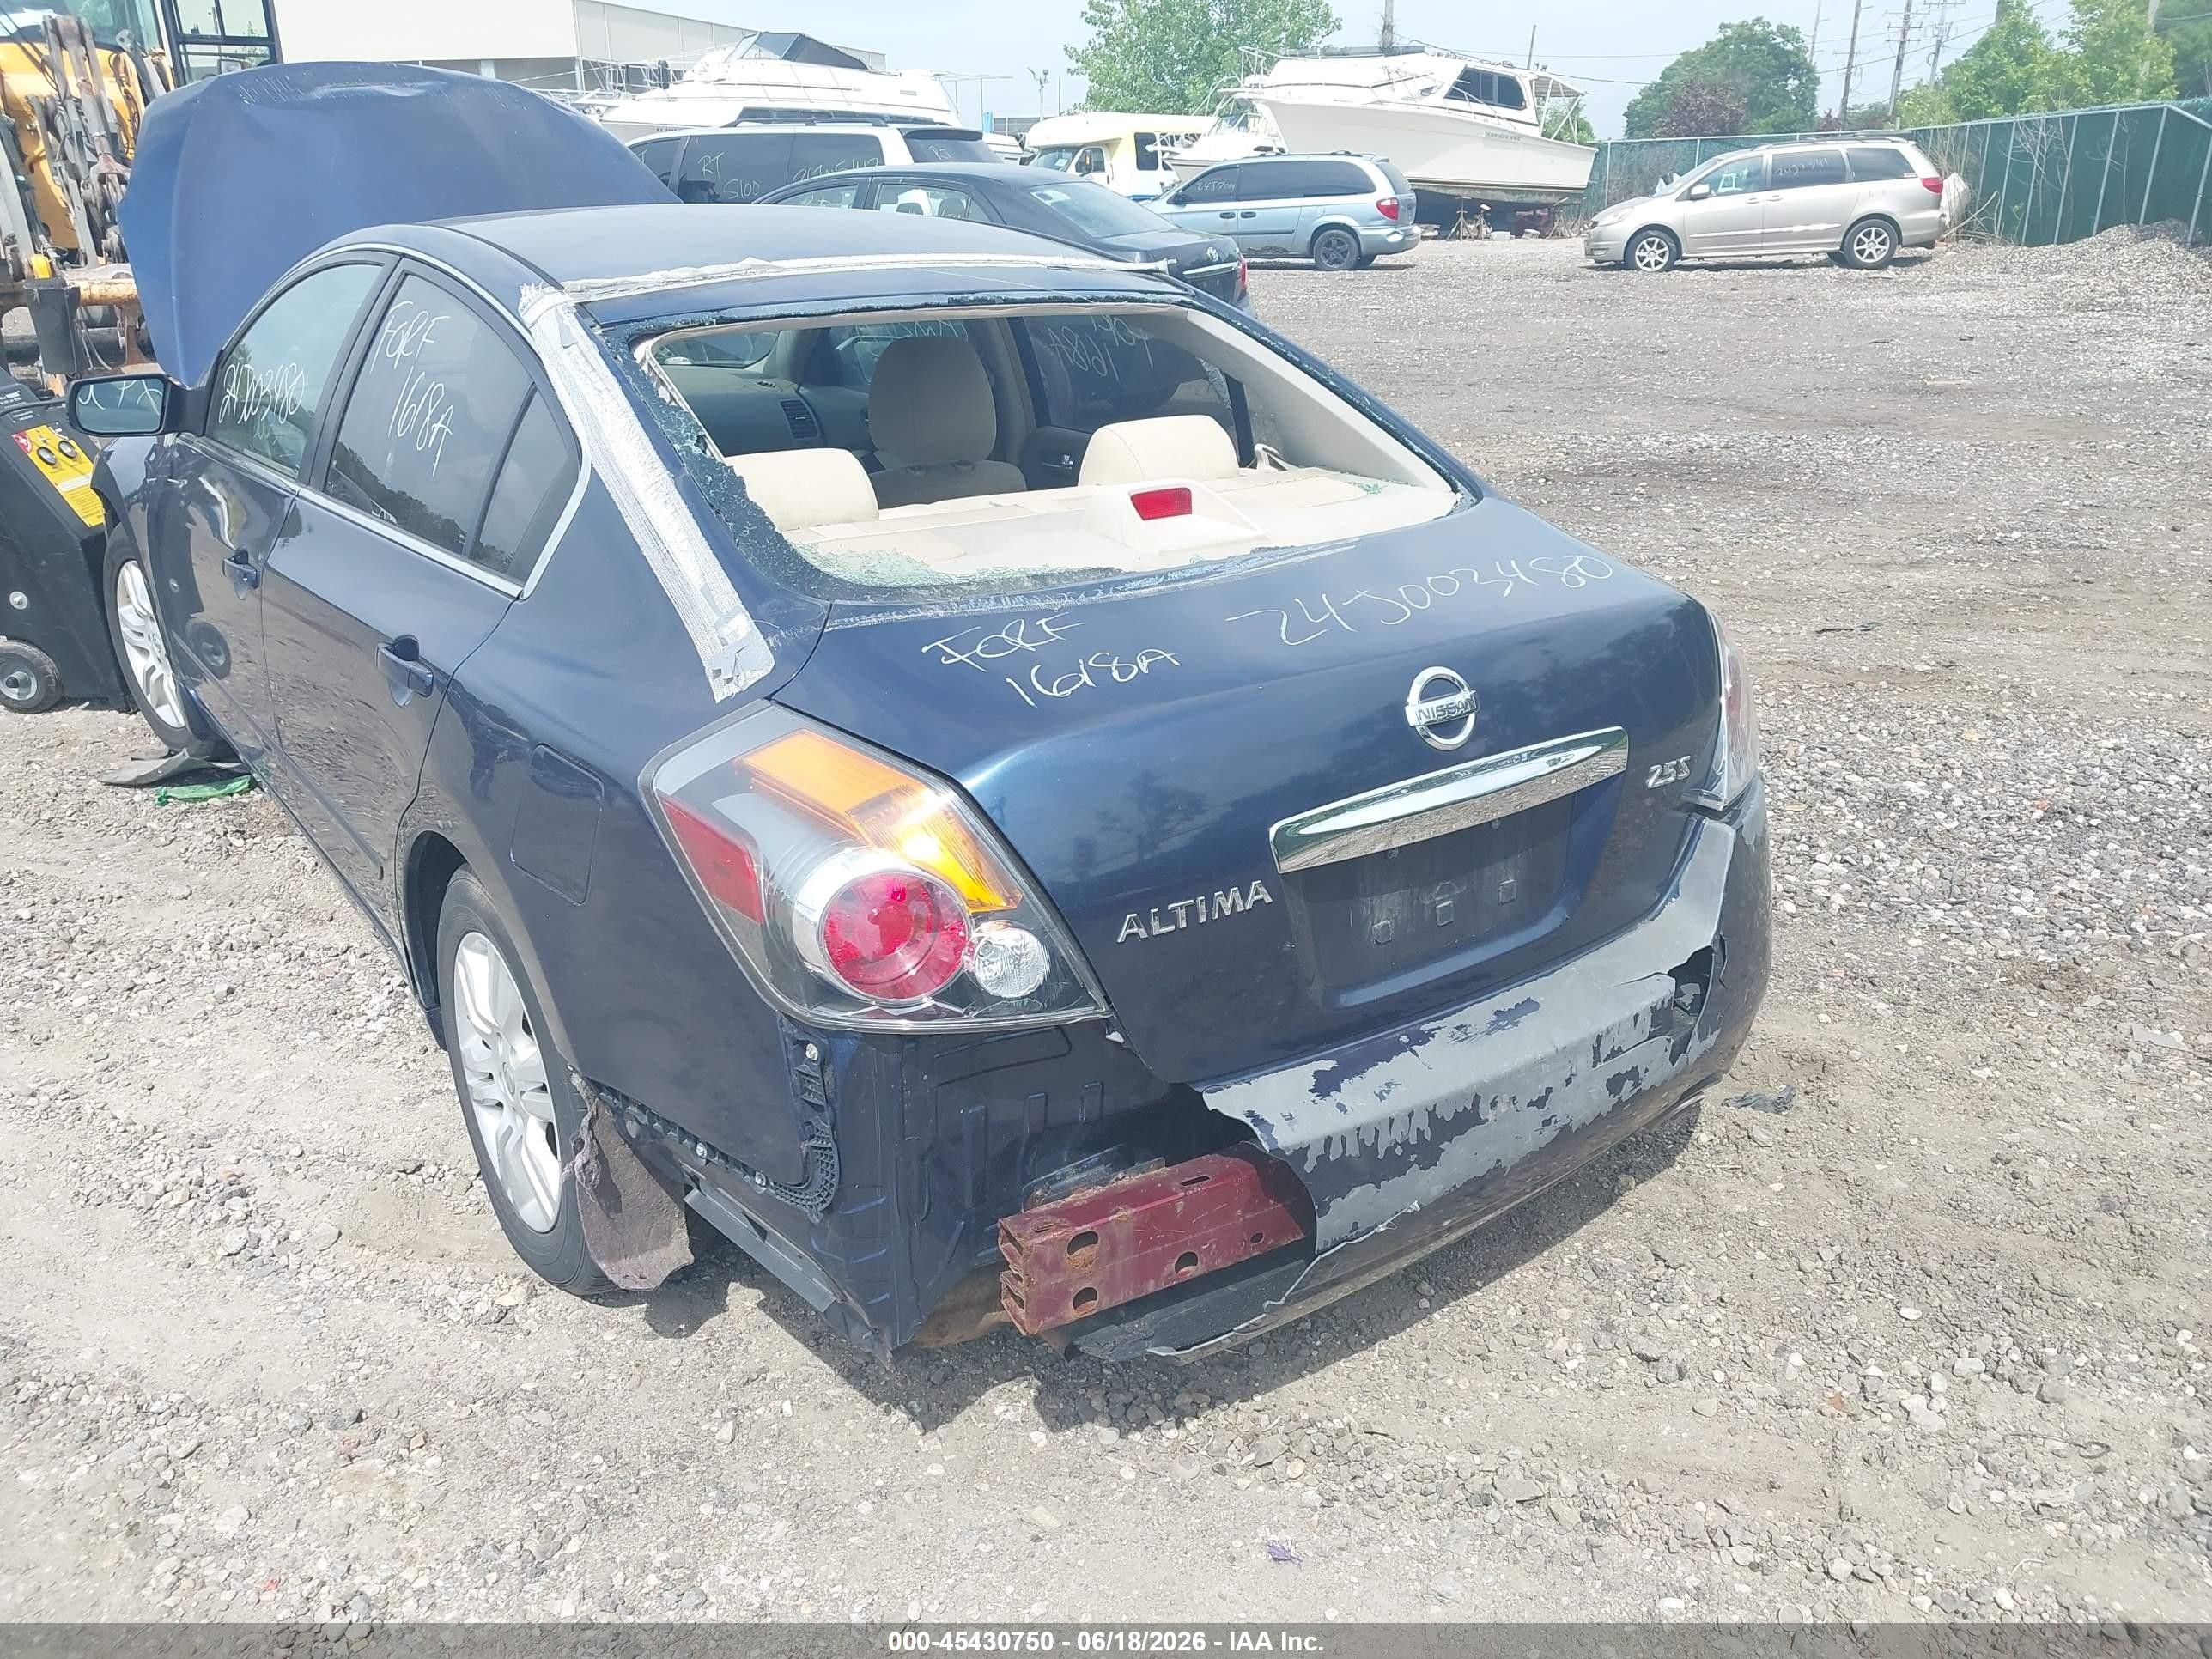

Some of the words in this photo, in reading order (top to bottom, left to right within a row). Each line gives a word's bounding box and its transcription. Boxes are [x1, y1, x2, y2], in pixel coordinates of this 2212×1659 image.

[697, 151, 725, 179] RT
[1415, 694, 1477, 722] NISSAN
[1116, 879, 1273, 944] ALTIMA
